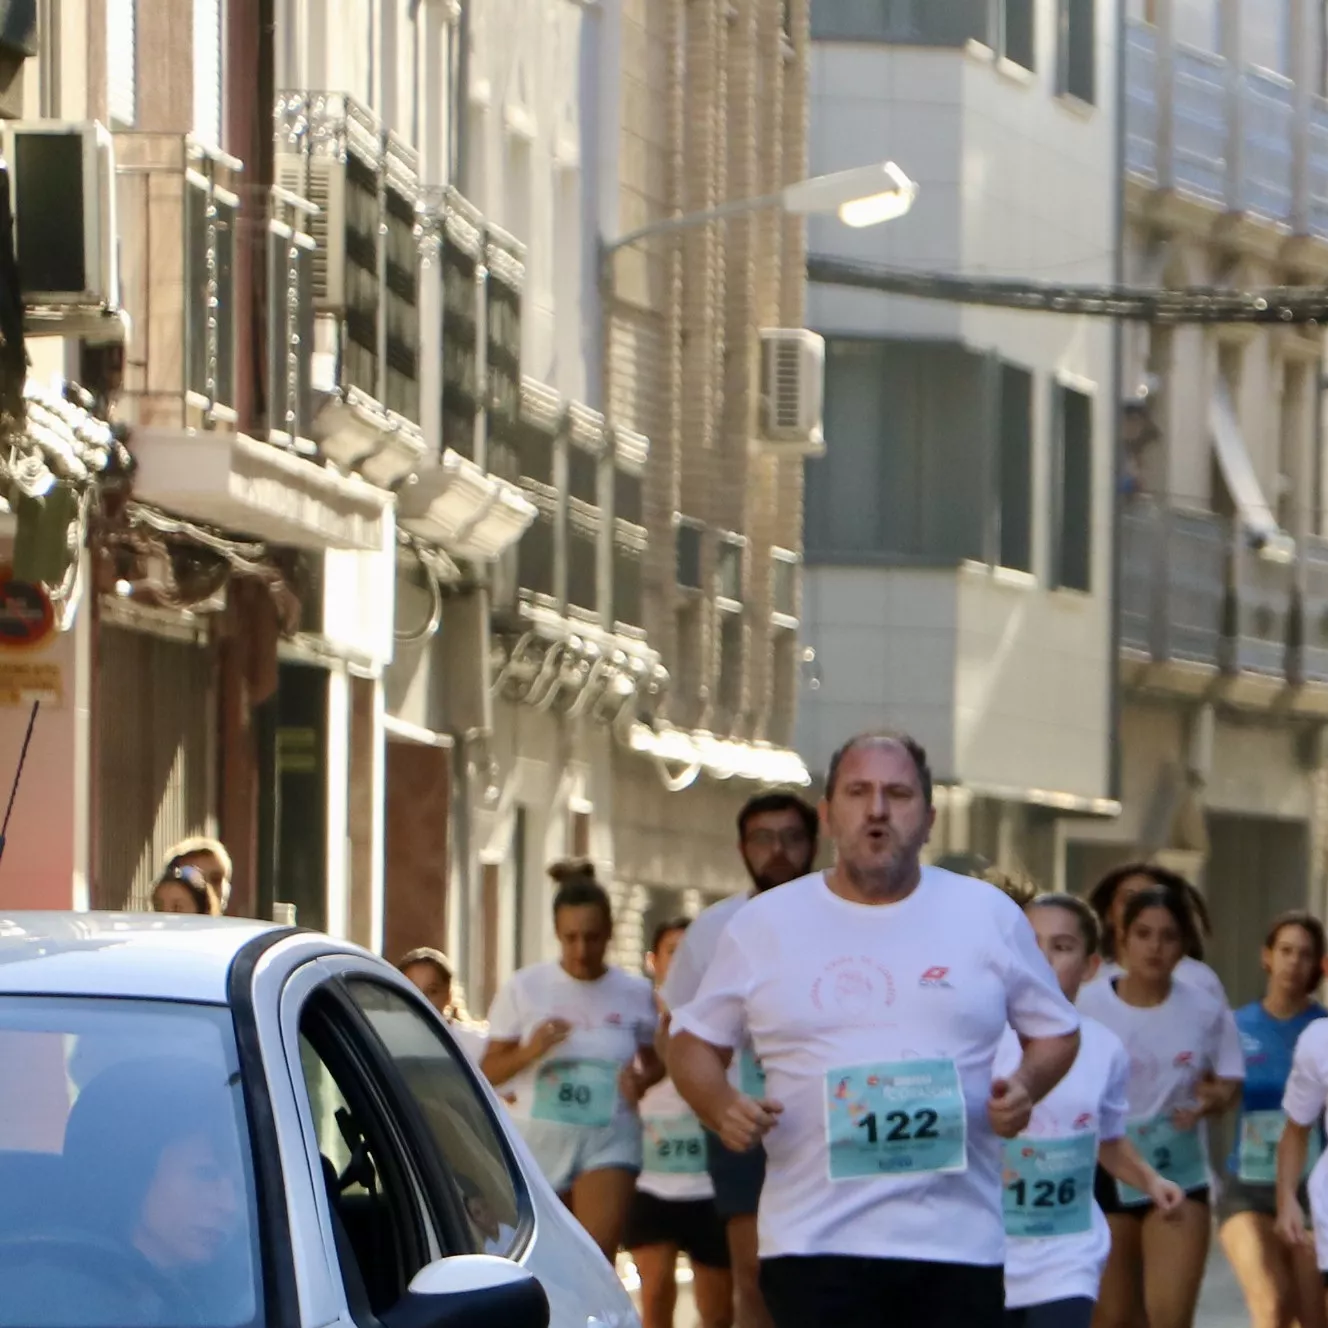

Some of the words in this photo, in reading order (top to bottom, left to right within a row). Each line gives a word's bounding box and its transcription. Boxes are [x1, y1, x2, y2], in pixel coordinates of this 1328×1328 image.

[558, 1082, 592, 1105] 80
[858, 1107, 940, 1144] 122
[1008, 1177, 1077, 1207] 126
